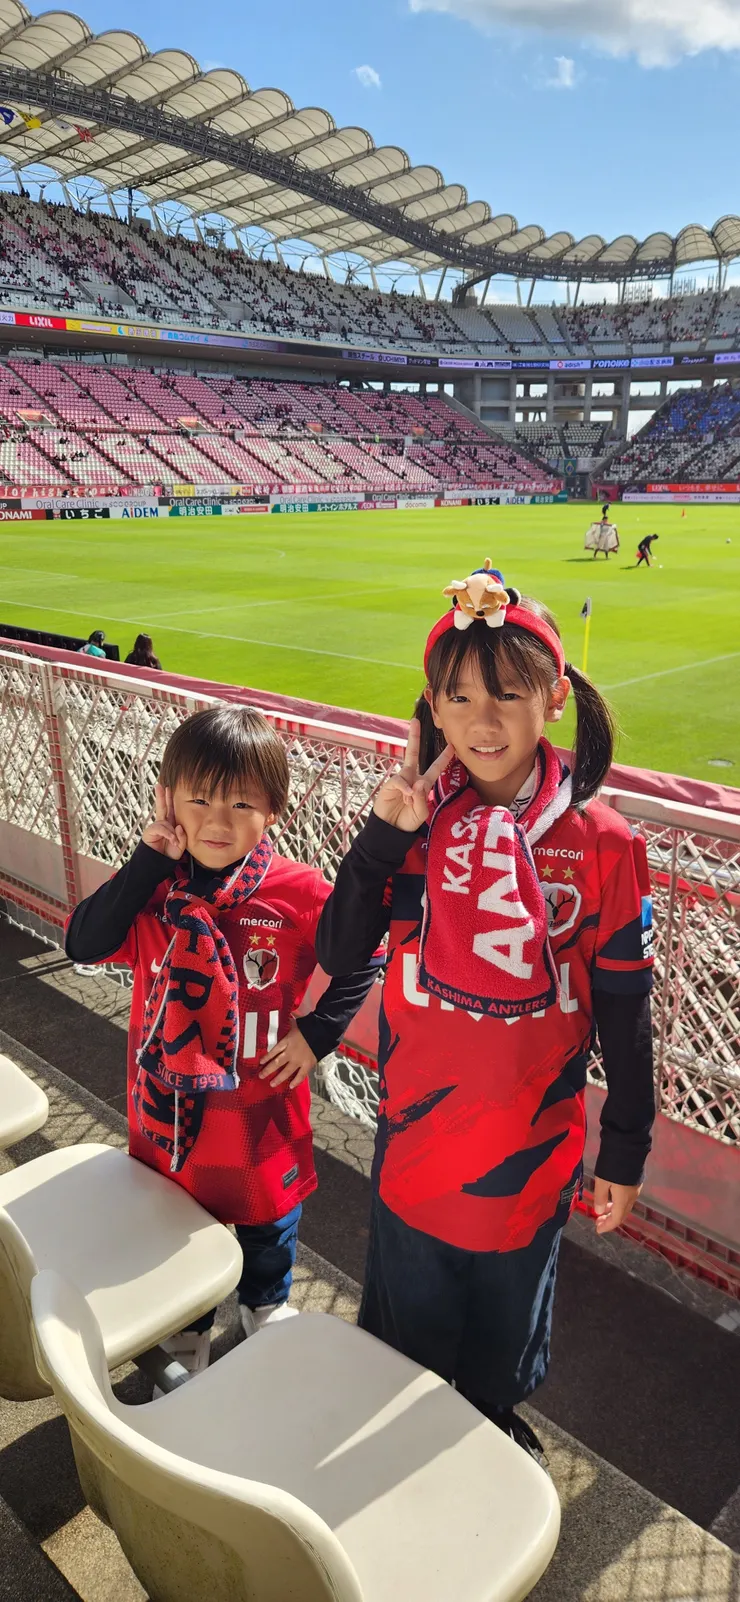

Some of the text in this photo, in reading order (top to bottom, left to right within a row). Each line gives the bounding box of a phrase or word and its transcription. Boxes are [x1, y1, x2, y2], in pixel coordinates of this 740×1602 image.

[29, 315, 54, 328] LIXIL
[36, 499, 55, 509] Oral
[56, 499, 75, 509] Care
[76, 498, 99, 509] Clinic
[169, 497, 185, 507] Oral
[185, 497, 202, 506] Care
[202, 496, 222, 506] Clinic
[440, 499, 462, 507] KONAMI
[65, 509, 103, 519] いちご
[178, 506, 213, 516] 明治安田
[279, 504, 309, 513] 明治安田
[533, 845, 584, 861] mercari
[239, 917, 283, 929] mercari
[427, 978, 547, 1015] KASHIMA ANTLERS
[155, 1062, 225, 1089] SINCE 1991
